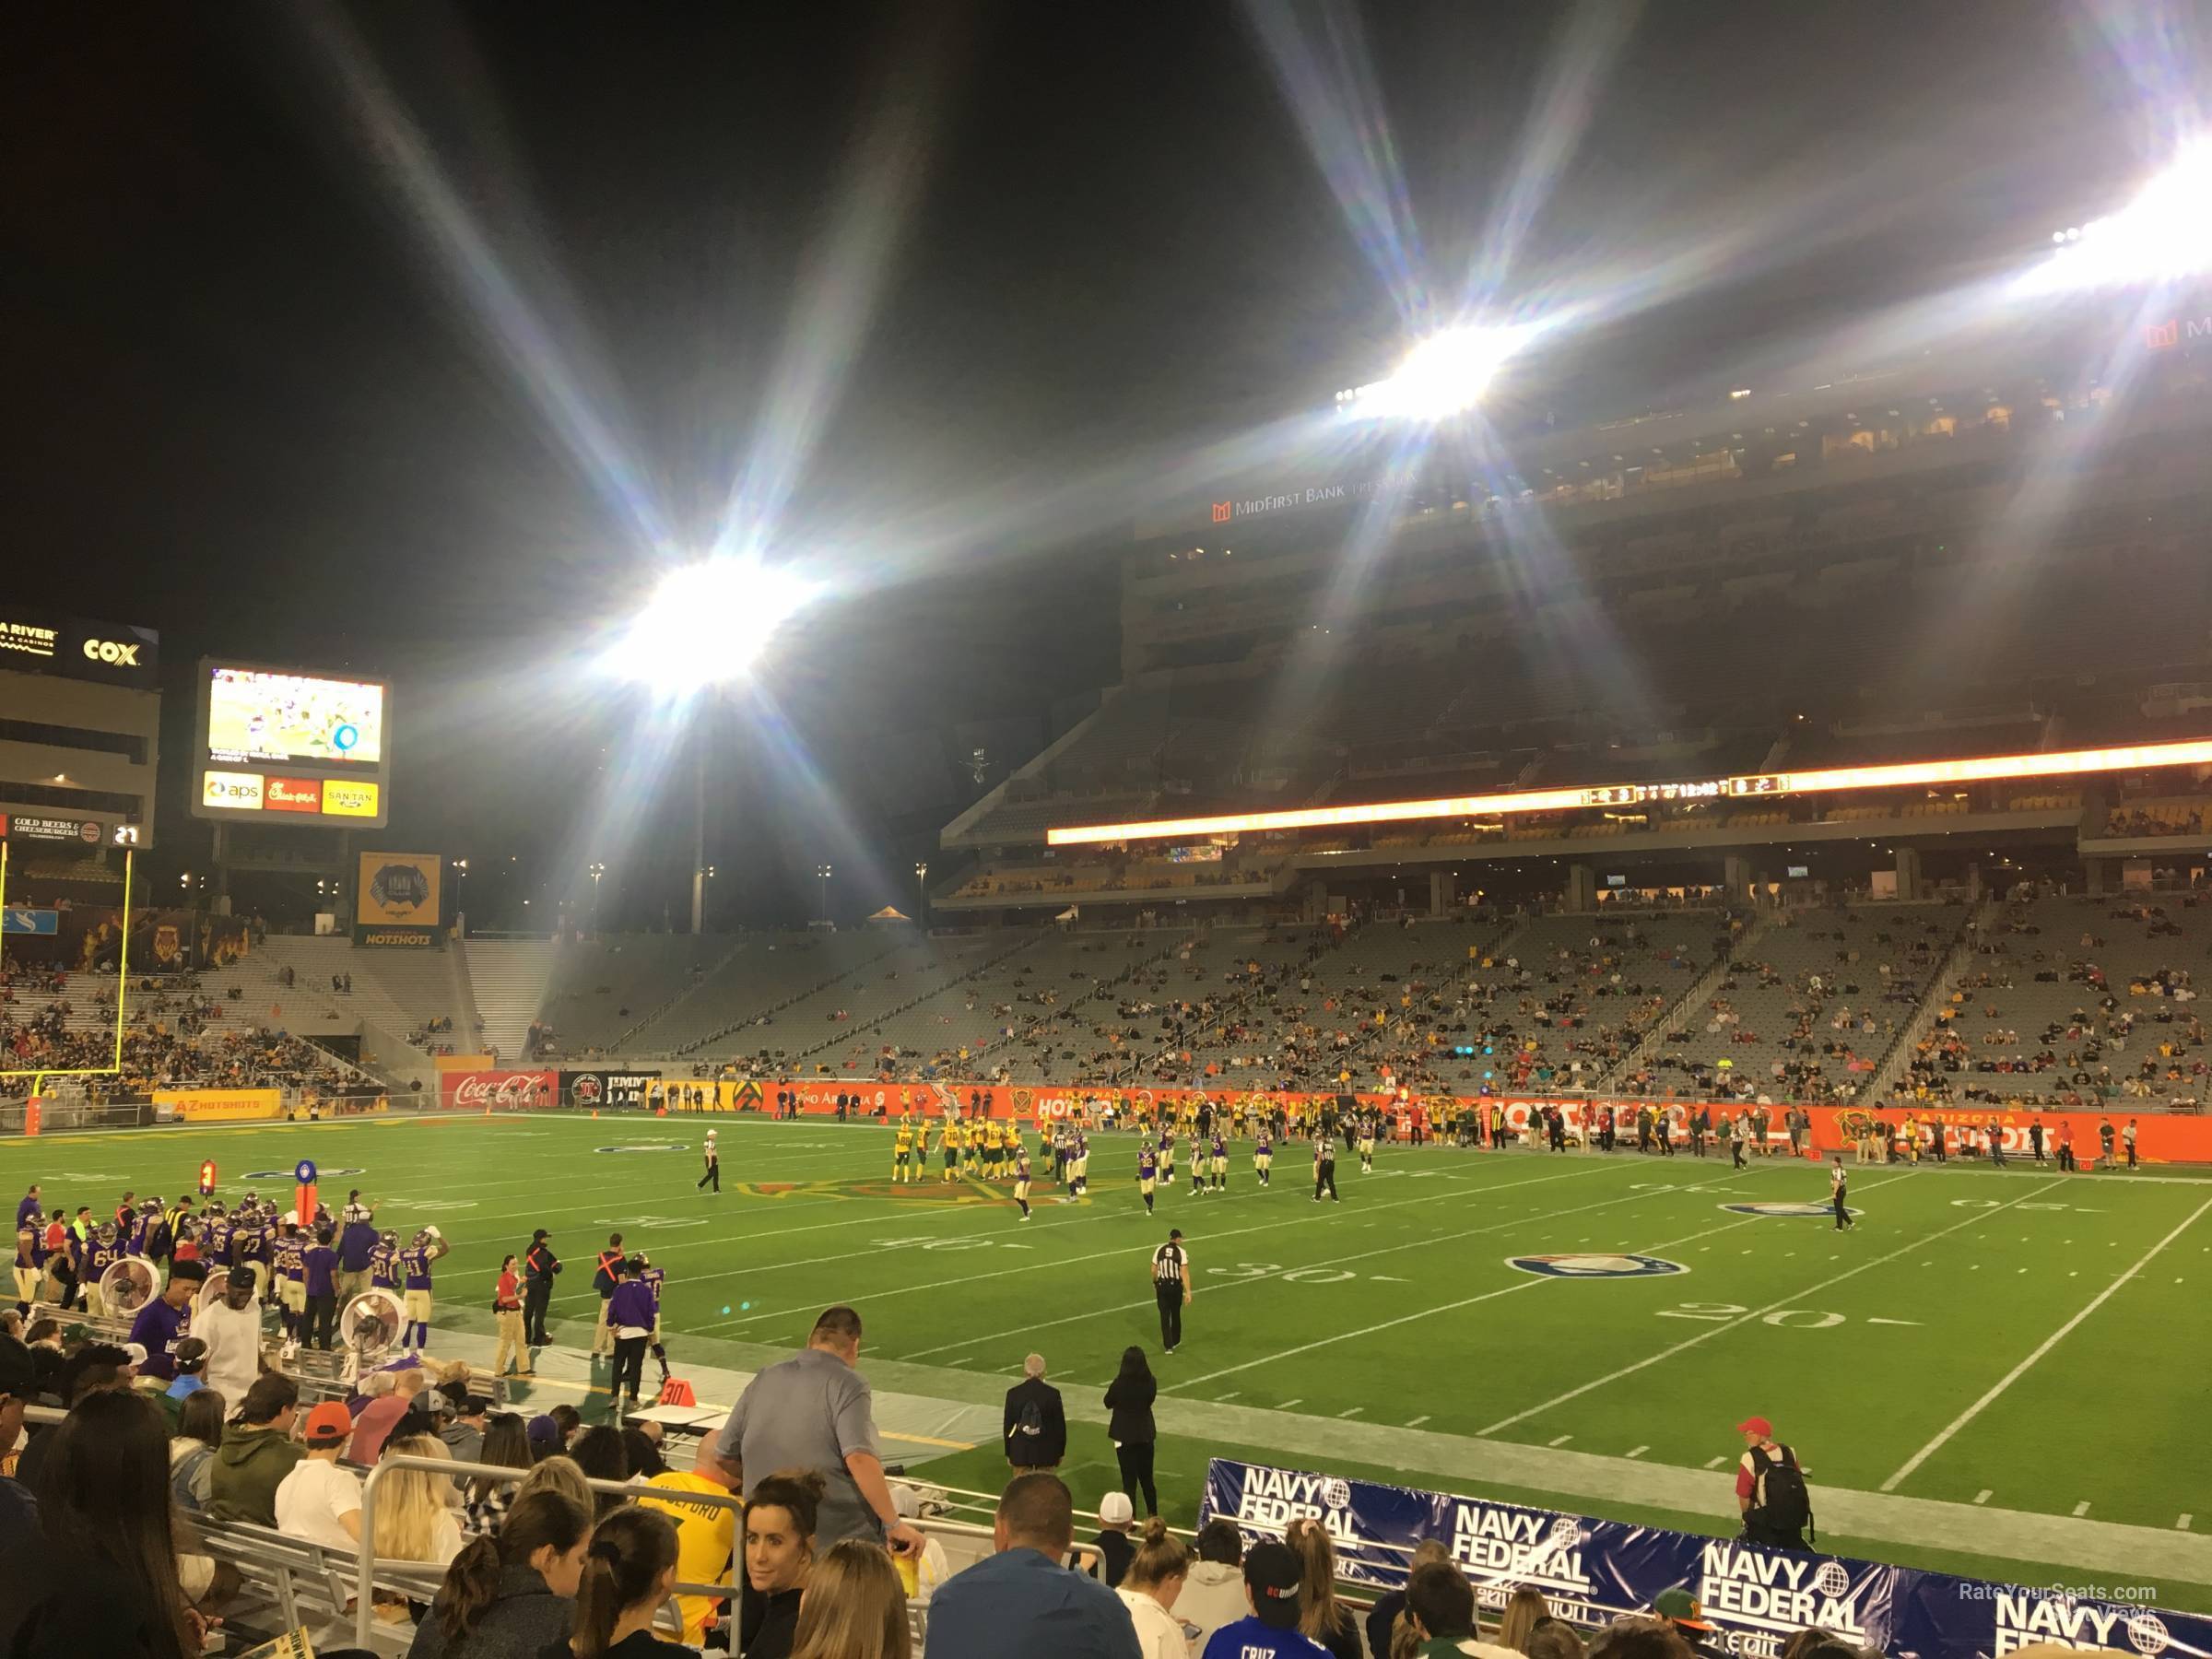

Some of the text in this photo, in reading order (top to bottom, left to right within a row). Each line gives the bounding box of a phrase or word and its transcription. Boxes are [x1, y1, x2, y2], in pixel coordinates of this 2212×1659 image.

[11, 624, 54, 641] RIVER
[83, 639, 140, 666] COX
[228, 785, 258, 799] aps
[352, 794, 372, 802] TAN
[14, 818, 40, 826] COLD
[41, 820, 72, 829] BEERS
[14, 825, 78, 836] CHEESEBURGERS
[366, 934, 431, 945] HOTSHOTS
[94, 1250, 119, 1267] 64
[663, 1383, 684, 1406] 30
[1243, 1467, 1322, 1504] NAVY
[1238, 1494, 1359, 1542] FEDERAL
[1456, 1504, 1546, 1545] NAVY
[1452, 1533, 1591, 1584] FEDERAL
[1703, 1545, 1809, 1591] NAVY
[1701, 1576, 1866, 1634] FEDERAL
[1996, 1593, 2119, 1645] NAVY
[288, 1630, 303, 1651] CREW
[1241, 1645, 1276, 1659] CRUZ
